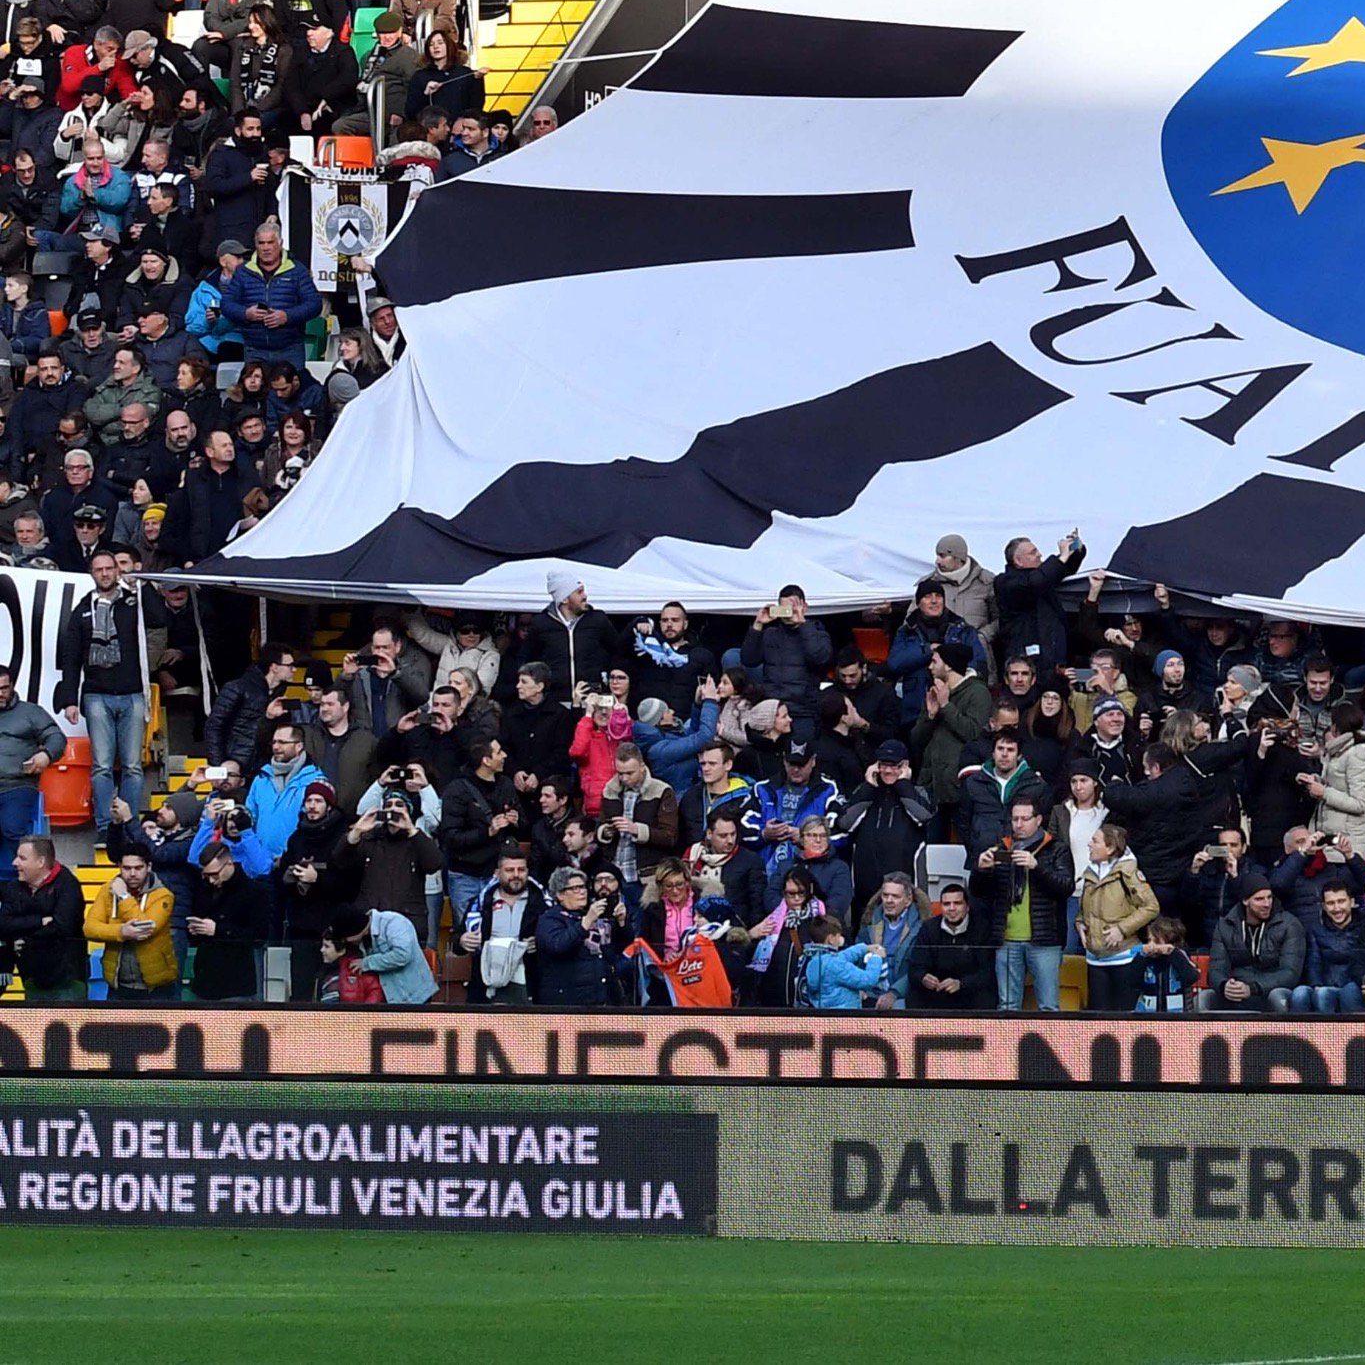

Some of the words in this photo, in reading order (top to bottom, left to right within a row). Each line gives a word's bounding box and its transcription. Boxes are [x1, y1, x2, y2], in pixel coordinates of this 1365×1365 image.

[112, 1120, 600, 1165] DELL'AGROALIMENTARE
[18, 1171, 197, 1212] REGIONE
[207, 1174, 342, 1215] FRIULI
[350, 1176, 532, 1219] VENEZIA
[541, 1178, 685, 1220] GIULIA
[830, 1140, 1112, 1218] DALLA
